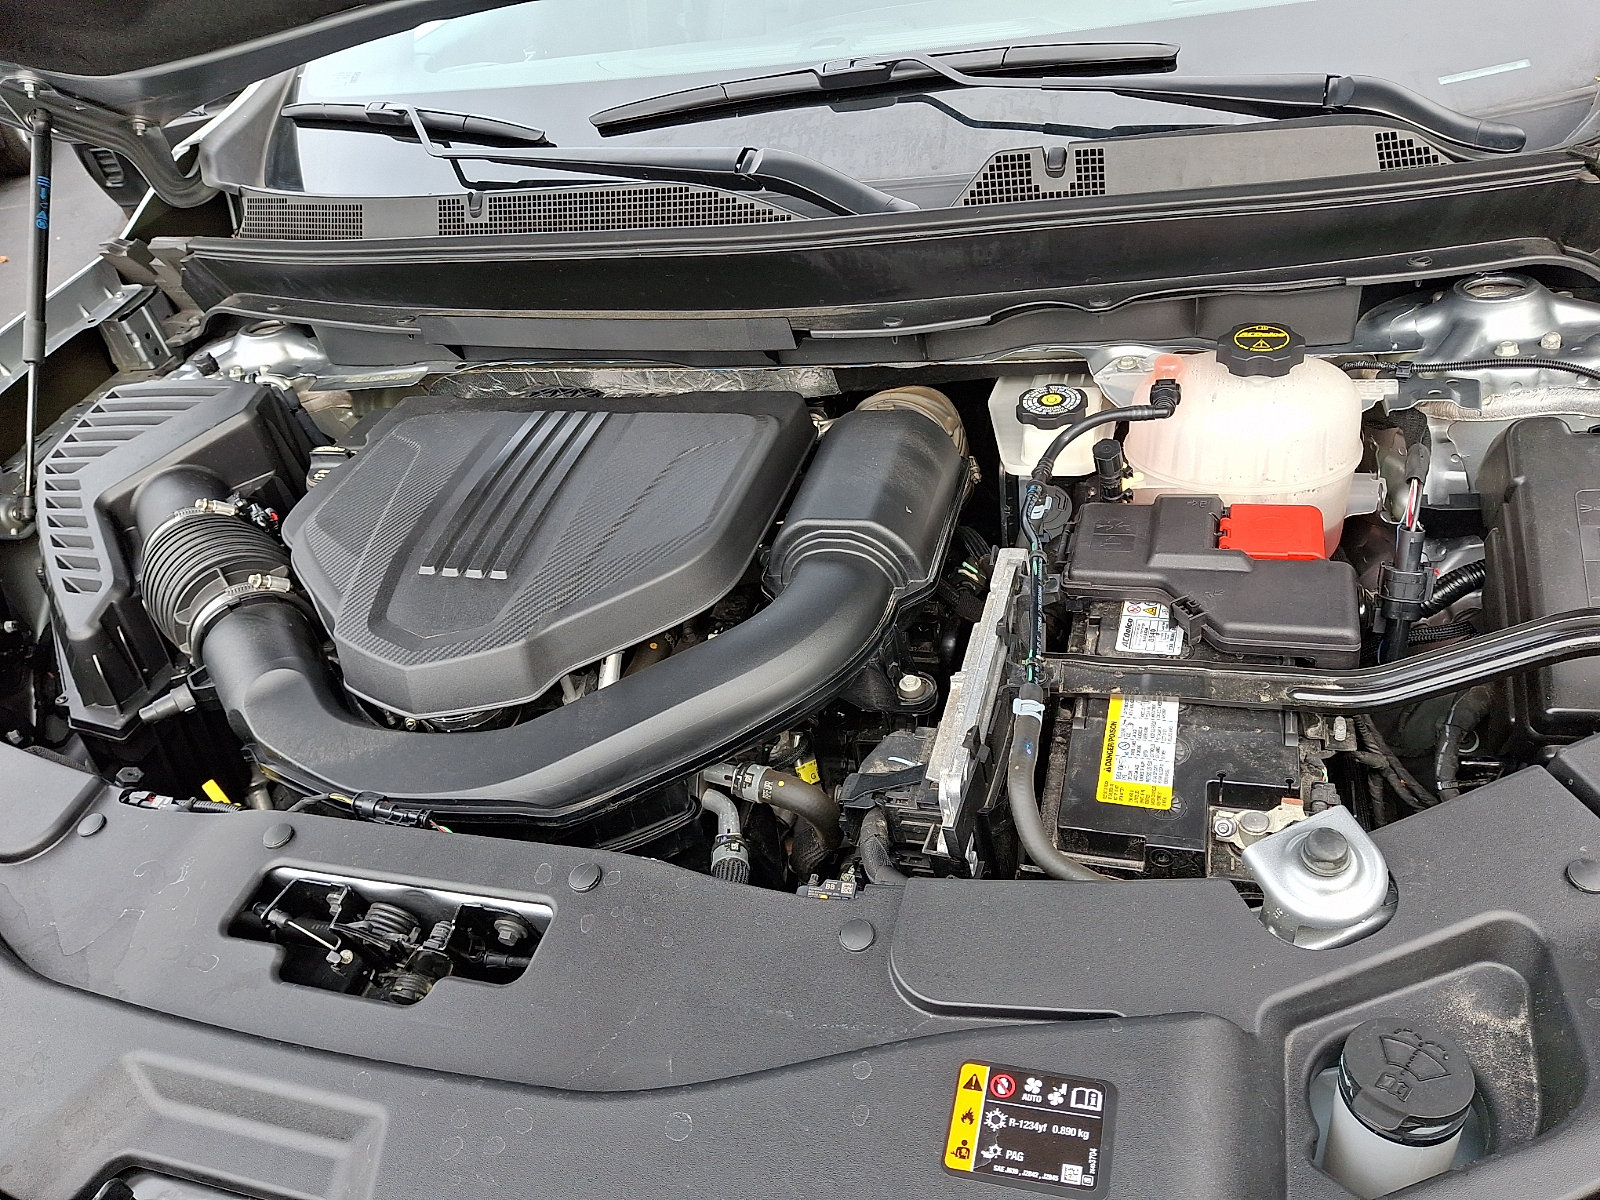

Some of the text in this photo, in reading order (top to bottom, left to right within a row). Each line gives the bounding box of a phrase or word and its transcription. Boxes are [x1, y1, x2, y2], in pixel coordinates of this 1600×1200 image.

[1122, 618, 1134, 648] ACDelco
[1021, 1093, 1043, 1104] AUTO
[1008, 1118, 1090, 1141] R-1234yf 0.890 kg
[1005, 1149, 1025, 1162] PAG
